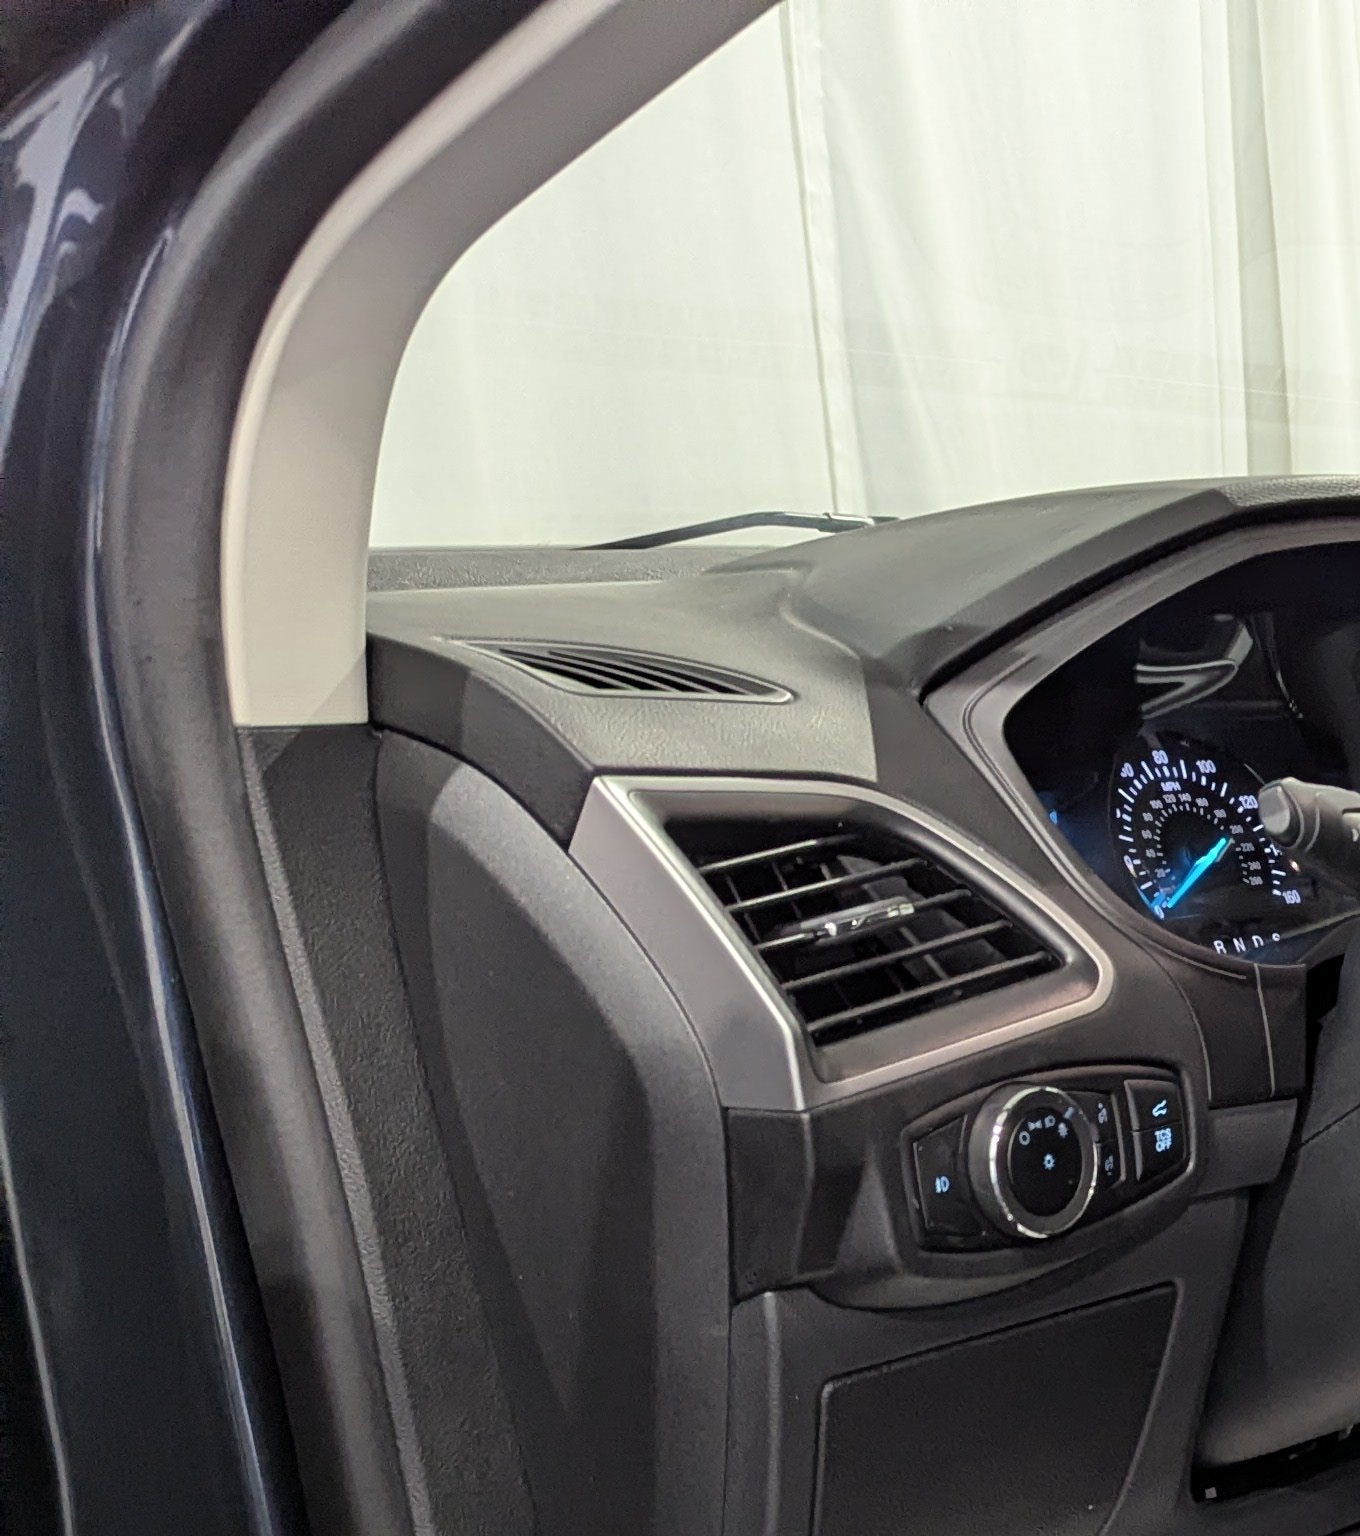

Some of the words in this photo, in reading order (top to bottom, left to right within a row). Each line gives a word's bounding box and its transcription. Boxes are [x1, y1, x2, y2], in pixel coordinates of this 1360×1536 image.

[1152, 750, 1168, 764] 80
[1196, 759, 1216, 774] 100
[1239, 795, 1259, 809] 120
[1282, 889, 1301, 905] 160
[1213, 939, 1227, 954] R
[1232, 936, 1246, 952] N
[1156, 1139, 1172, 1152] OFF
